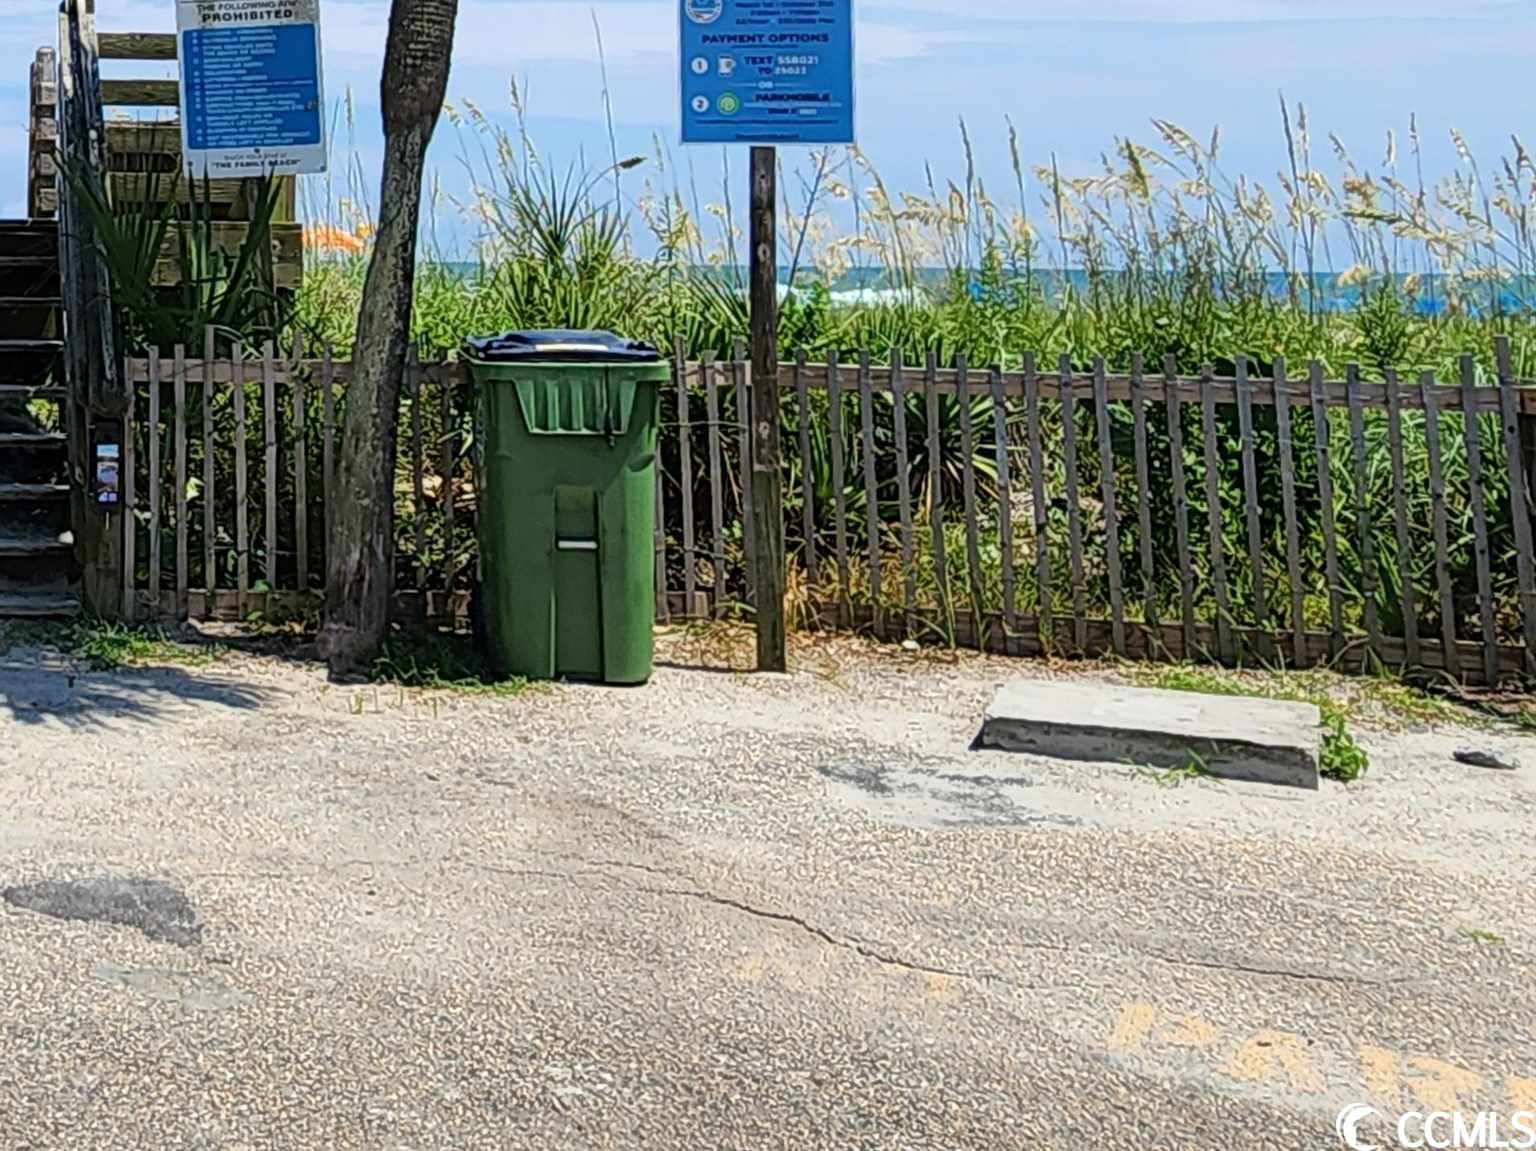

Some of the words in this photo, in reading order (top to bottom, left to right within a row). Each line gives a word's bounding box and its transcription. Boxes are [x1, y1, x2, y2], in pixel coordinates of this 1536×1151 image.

[197, 4, 216, 12] THE
[218, 1, 276, 11] FOLLOWING
[202, 9, 293, 23] PROHIBITED
[702, 34, 765, 44] PAYMENT
[768, 33, 830, 43] OPTIONS
[744, 55, 773, 65] TEXT
[757, 67, 773, 76] TO
